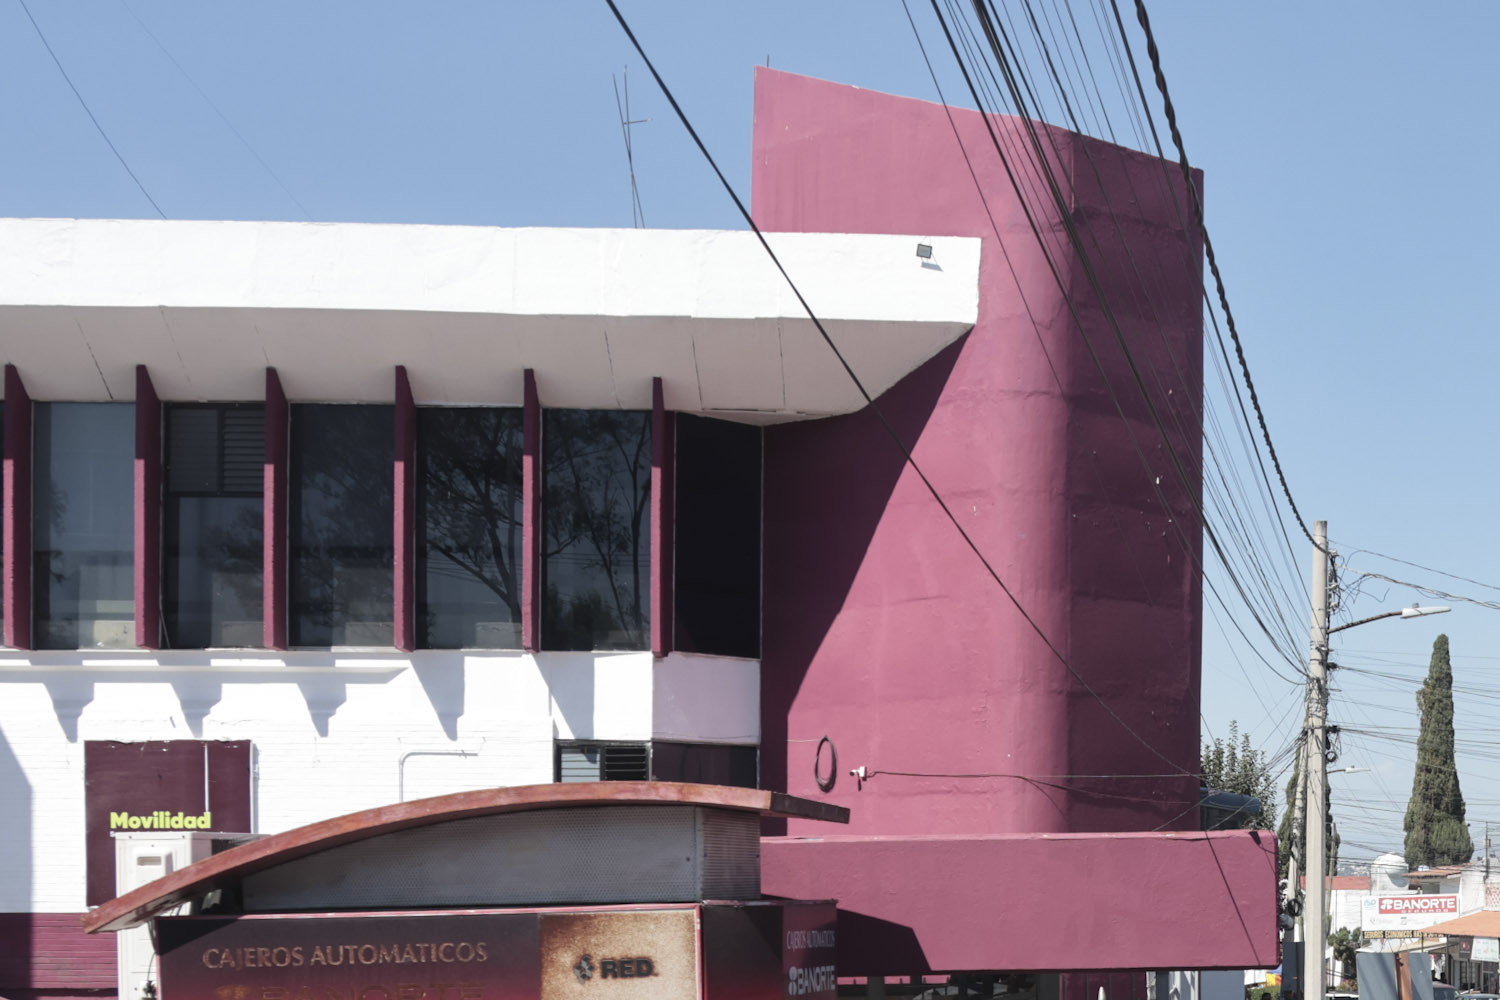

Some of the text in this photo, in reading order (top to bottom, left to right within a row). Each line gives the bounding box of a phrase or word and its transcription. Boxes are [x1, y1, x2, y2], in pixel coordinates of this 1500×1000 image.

[110, 811, 212, 830] Movilidad
[1393, 898, 1456, 911] BANORTE
[202, 942, 488, 971] CAJEROS AUTOMATICOS
[797, 965, 836, 995] BANORTE
